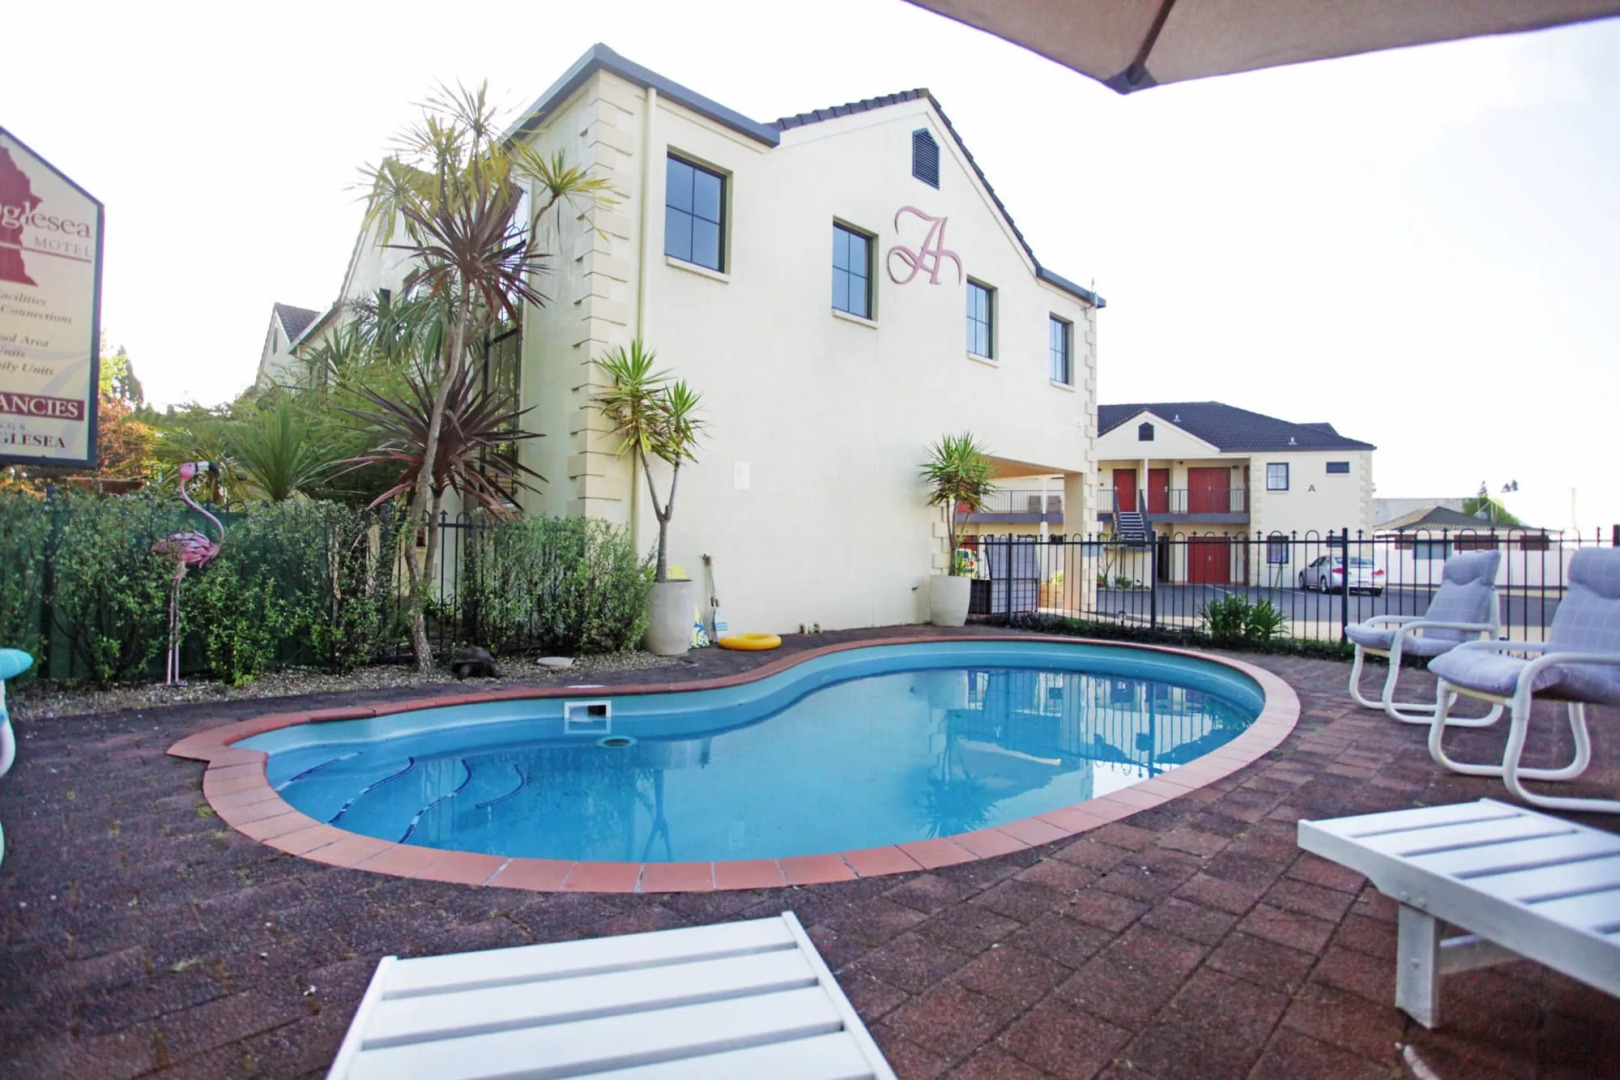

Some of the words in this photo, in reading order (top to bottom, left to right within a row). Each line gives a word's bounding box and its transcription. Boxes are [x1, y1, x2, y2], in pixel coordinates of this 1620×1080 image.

[0, 201, 92, 239] glesea
[34, 235, 92, 258] MOTEL
[20, 335, 49, 348] Area
[0, 361, 19, 373] ily
[22, 363, 54, 376] Units
[0, 393, 79, 418] ANCIES
[1307, 484, 1316, 493] A
